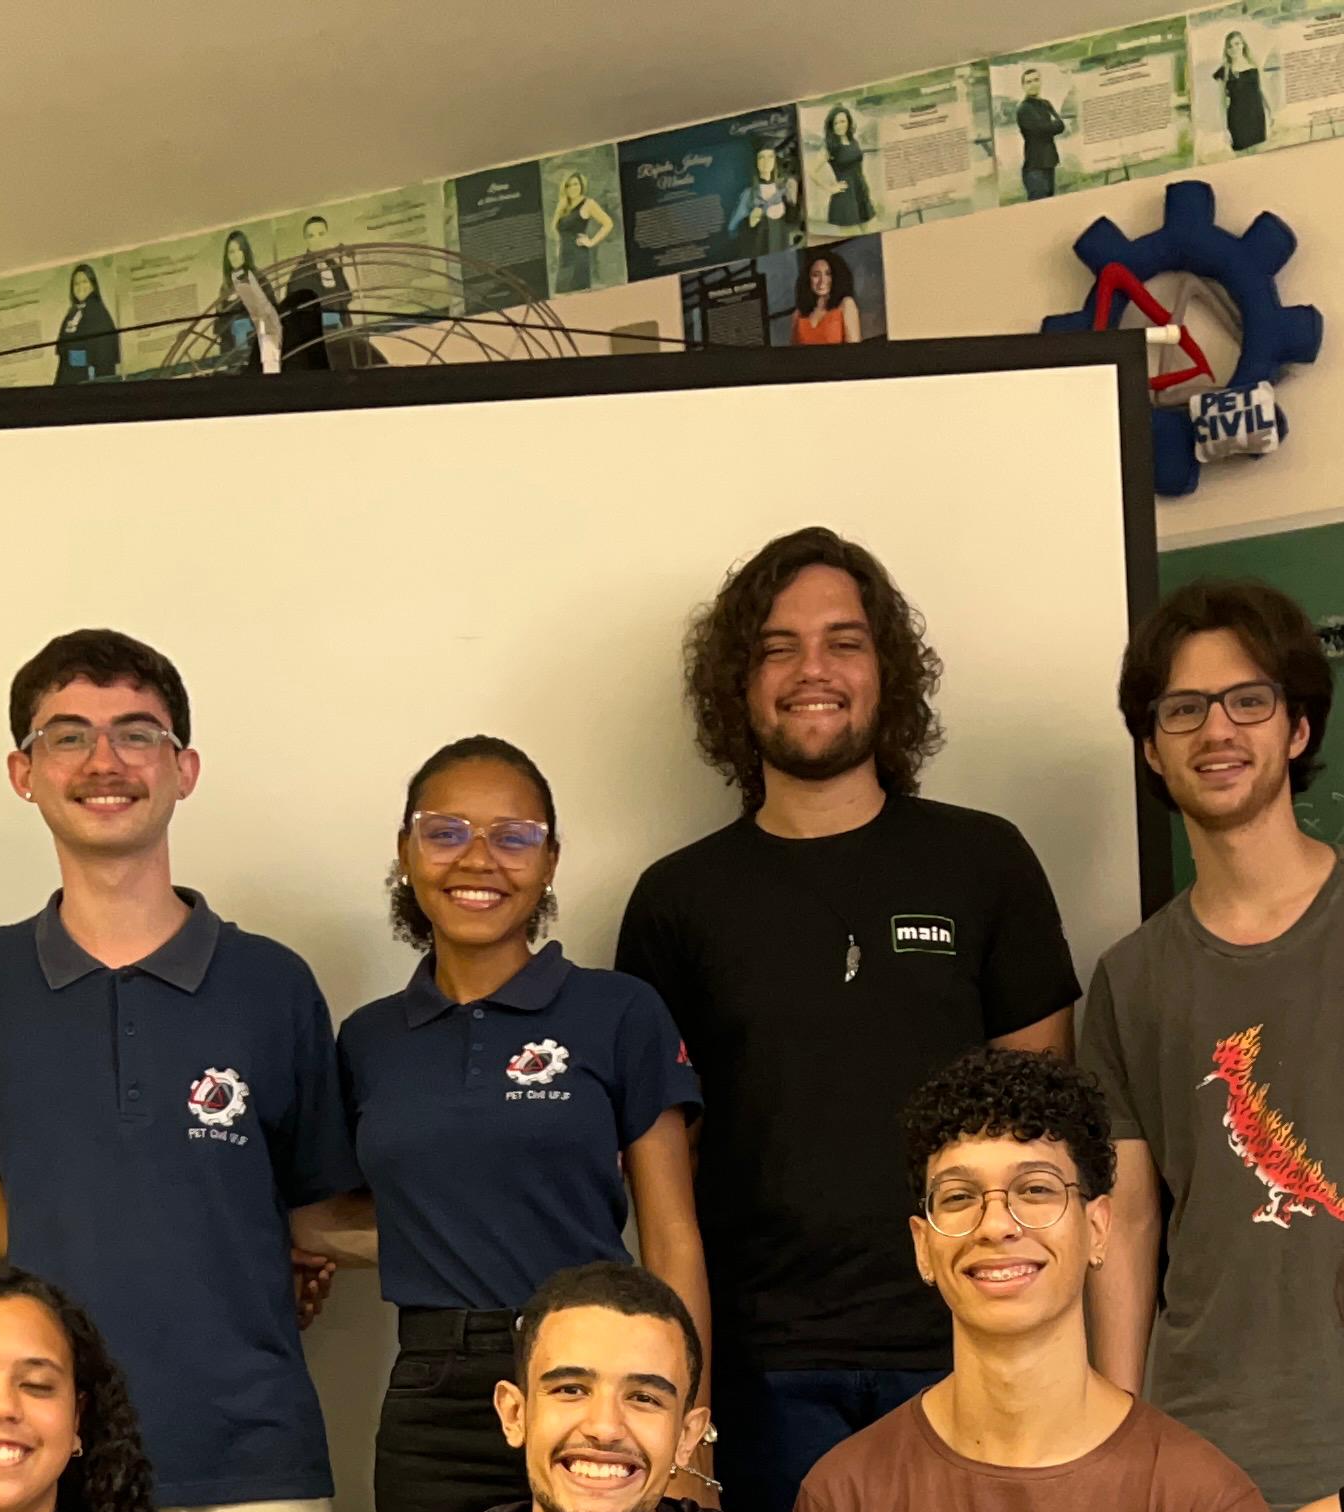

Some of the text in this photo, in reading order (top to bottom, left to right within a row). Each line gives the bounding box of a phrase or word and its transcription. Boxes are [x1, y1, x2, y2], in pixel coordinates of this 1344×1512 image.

[896, 926, 951, 944] main
[505, 1090, 524, 1101] PET
[188, 1127, 207, 1140] PET
